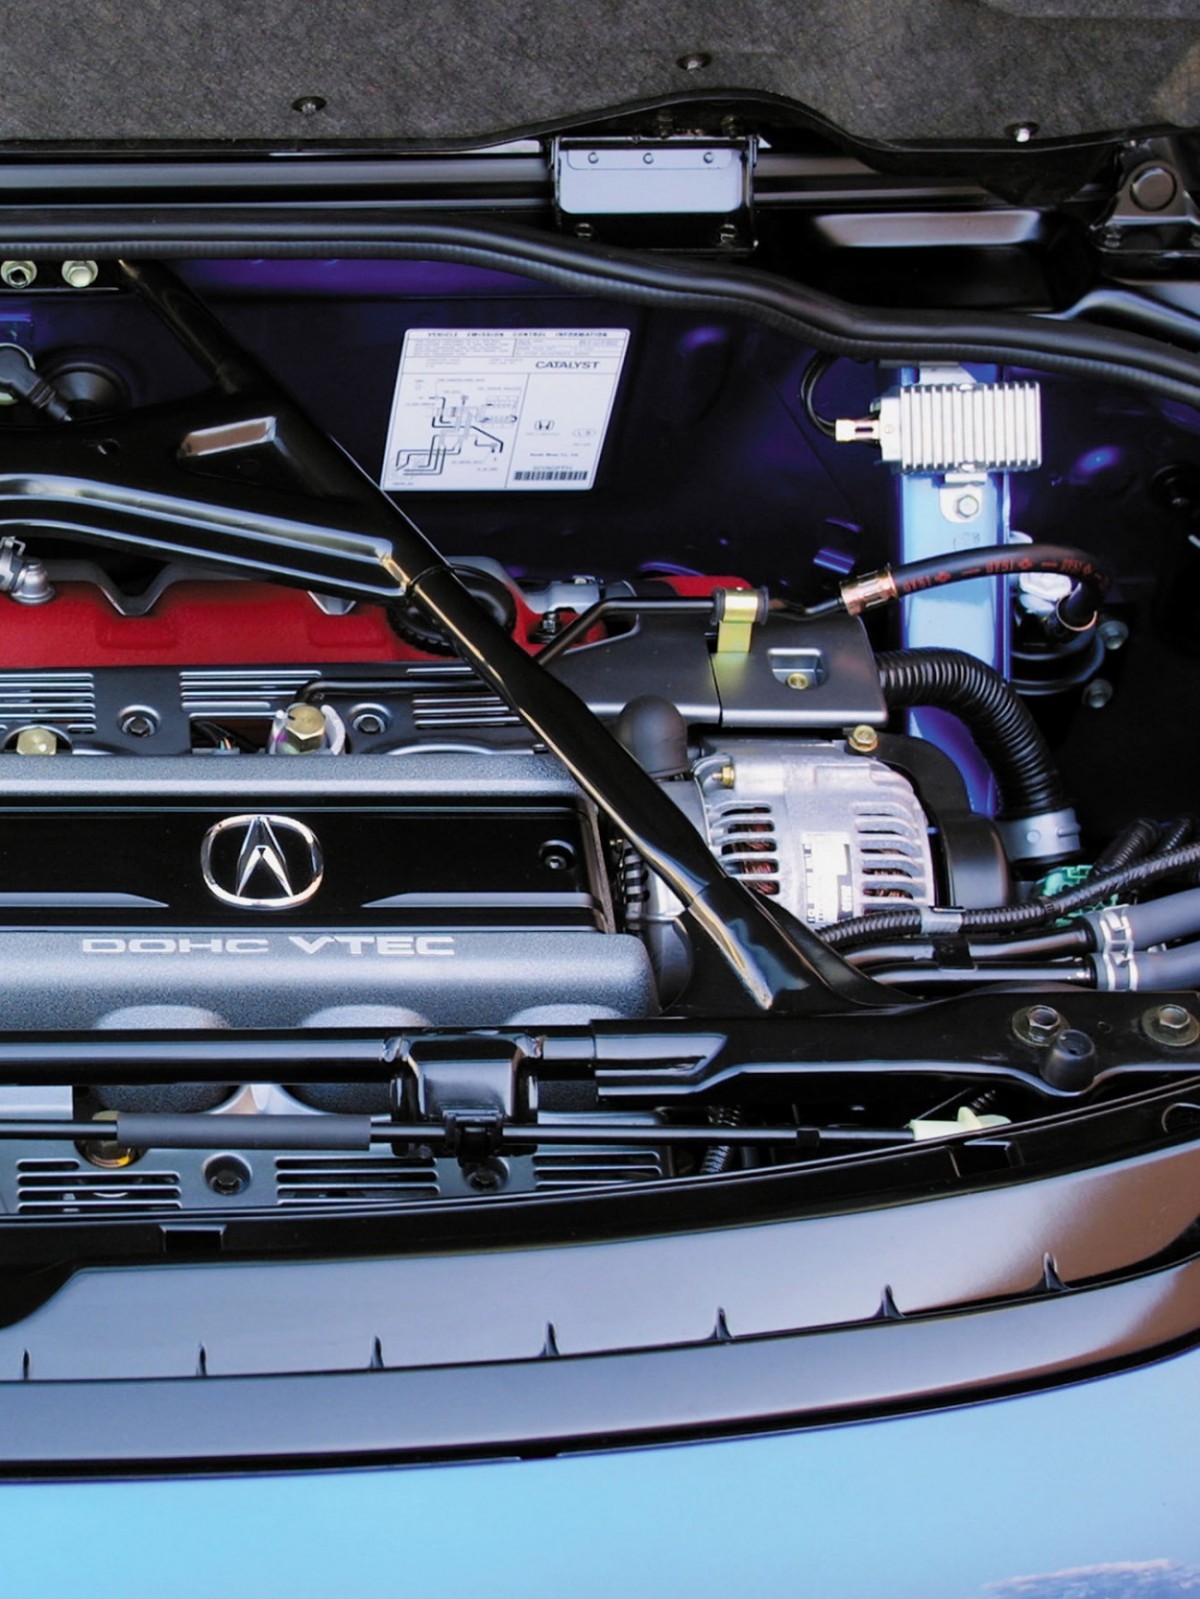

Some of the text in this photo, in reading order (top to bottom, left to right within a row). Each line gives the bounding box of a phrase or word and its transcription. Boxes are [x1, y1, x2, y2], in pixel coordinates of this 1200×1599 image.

[535, 361, 600, 369] CATALYST
[82, 936, 455, 955] DOHC VTEC
